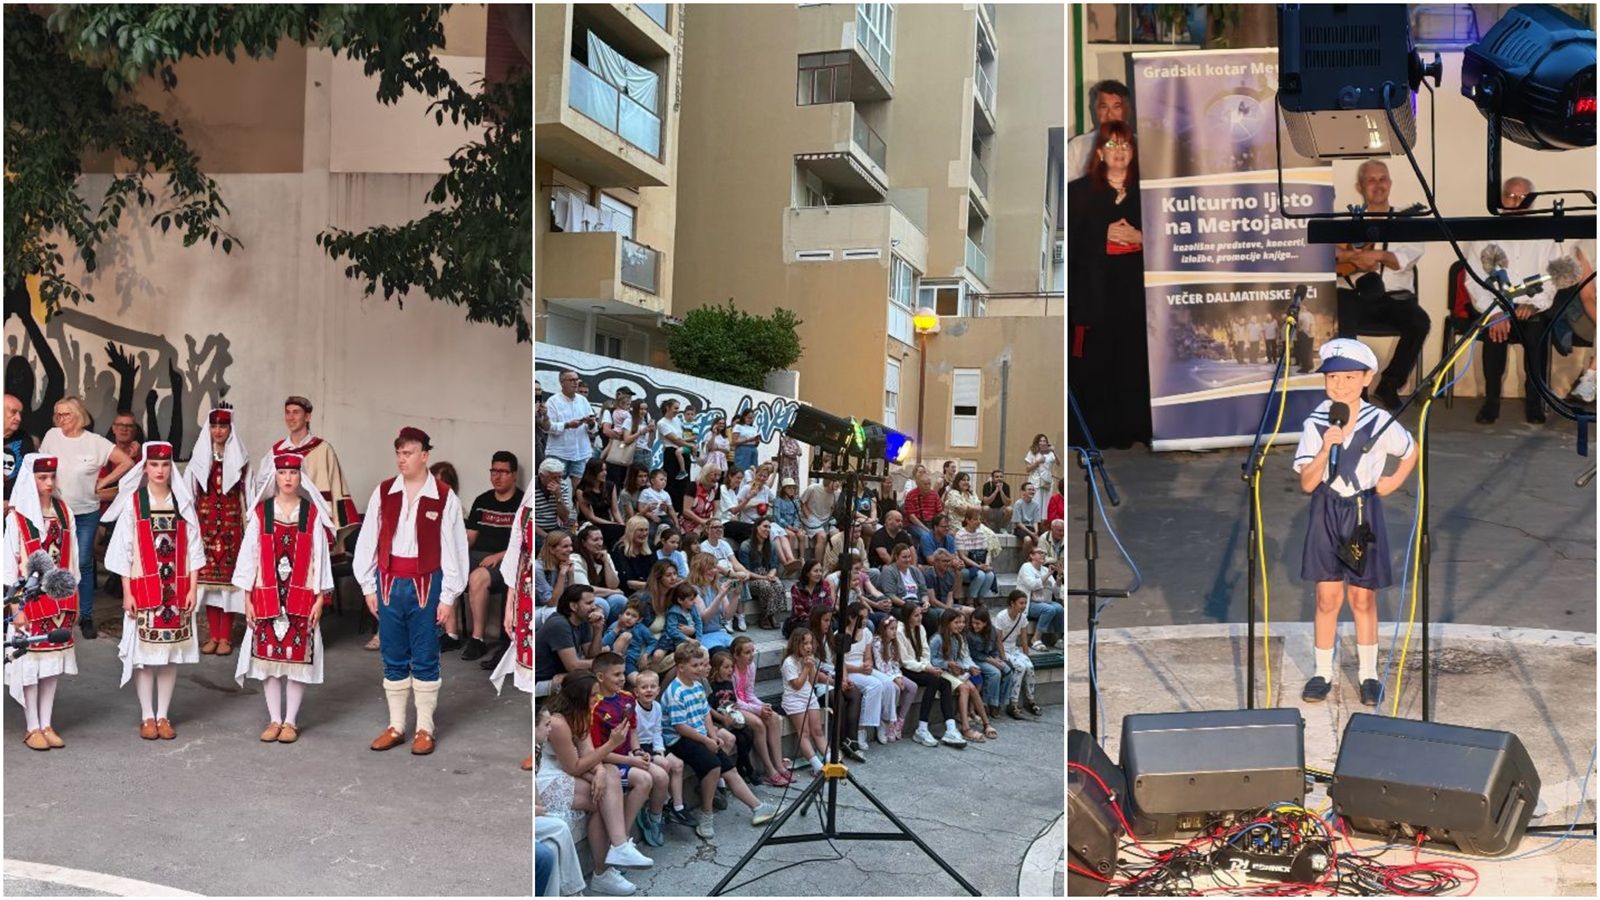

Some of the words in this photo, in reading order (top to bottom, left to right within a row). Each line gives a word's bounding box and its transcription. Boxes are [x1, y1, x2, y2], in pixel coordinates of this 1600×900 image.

[1143, 64, 1202, 79] Gradski
[1205, 63, 1248, 77] kotar
[1162, 195, 1258, 213] Kulturno
[1263, 192, 1314, 212] ljeto
[1165, 221, 1192, 236] na
[1197, 214, 1308, 236] Mertojaku
[1166, 292, 1204, 306] VEČER
[1206, 289, 1291, 304] DALMATINSKE
[1292, 285, 1317, 300] ČI
